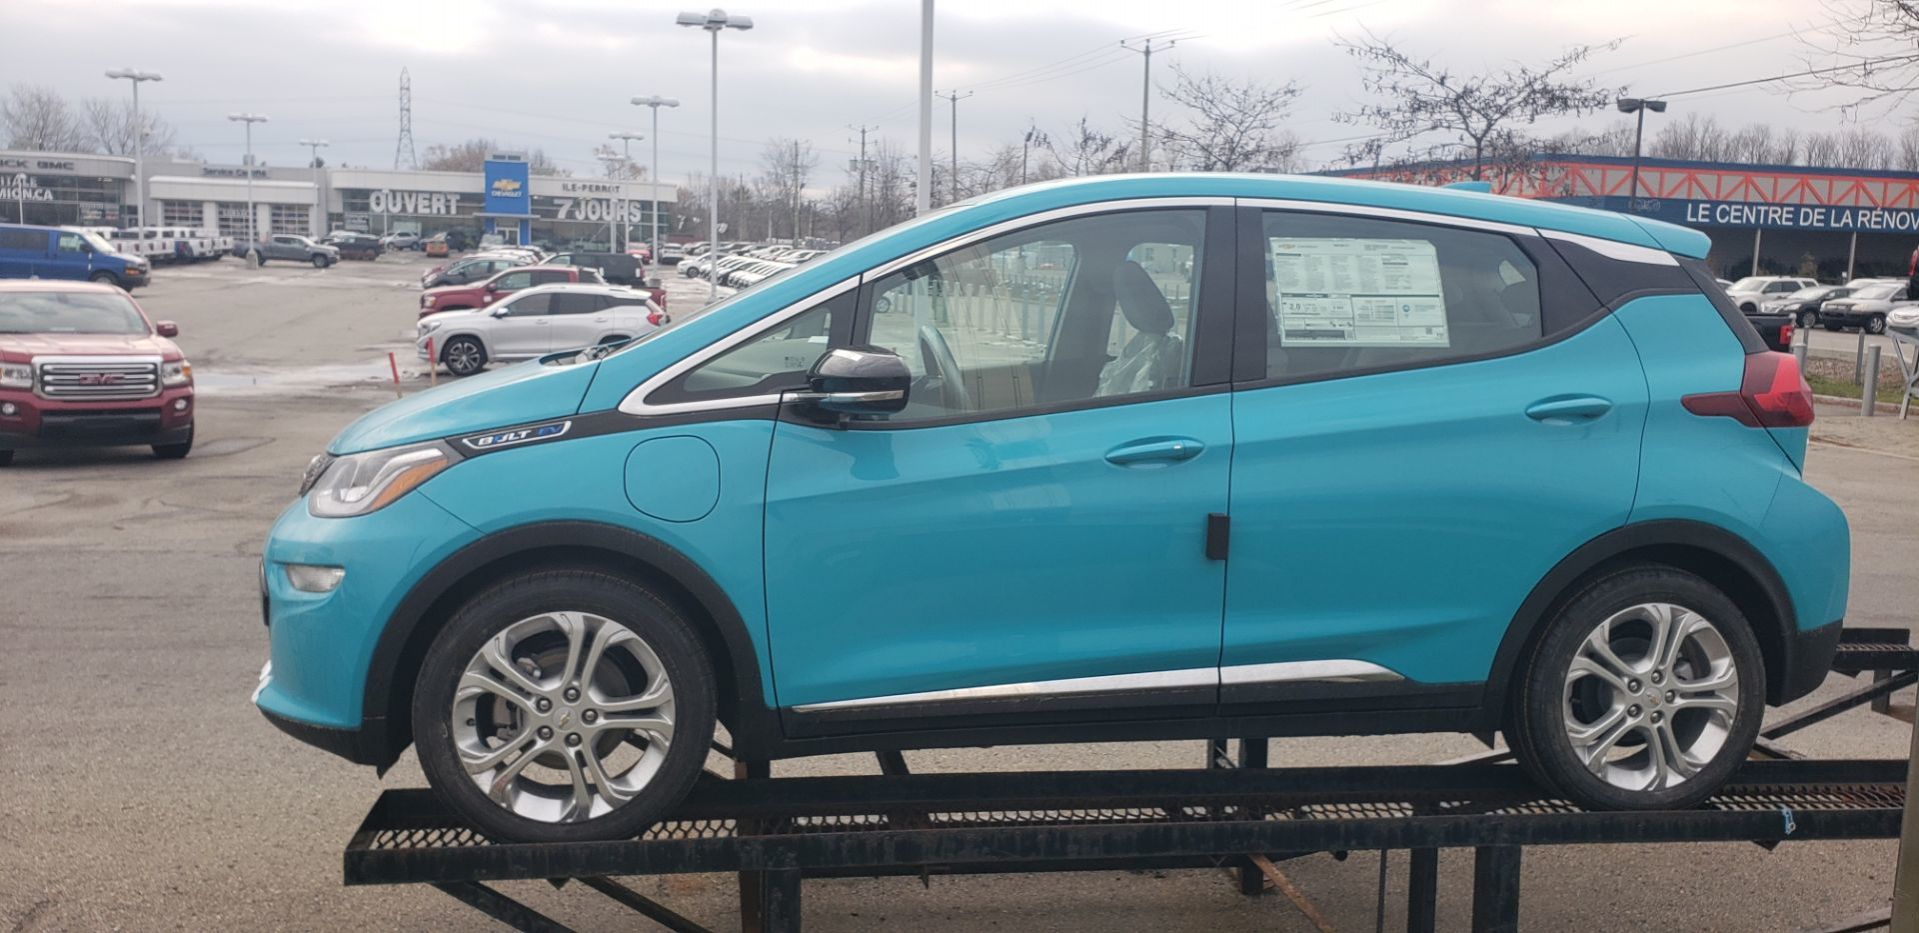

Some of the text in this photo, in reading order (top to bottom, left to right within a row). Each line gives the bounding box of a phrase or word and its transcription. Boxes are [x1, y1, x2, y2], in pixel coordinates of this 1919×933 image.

[37, 161, 74, 169] GMC
[369, 190, 460, 215] OUVERT
[553, 198, 641, 222] 7 JOURS
[1687, 203, 1919, 230] LE CENTRE DE LA RÉNOV
[80, 373, 125, 385] GMC
